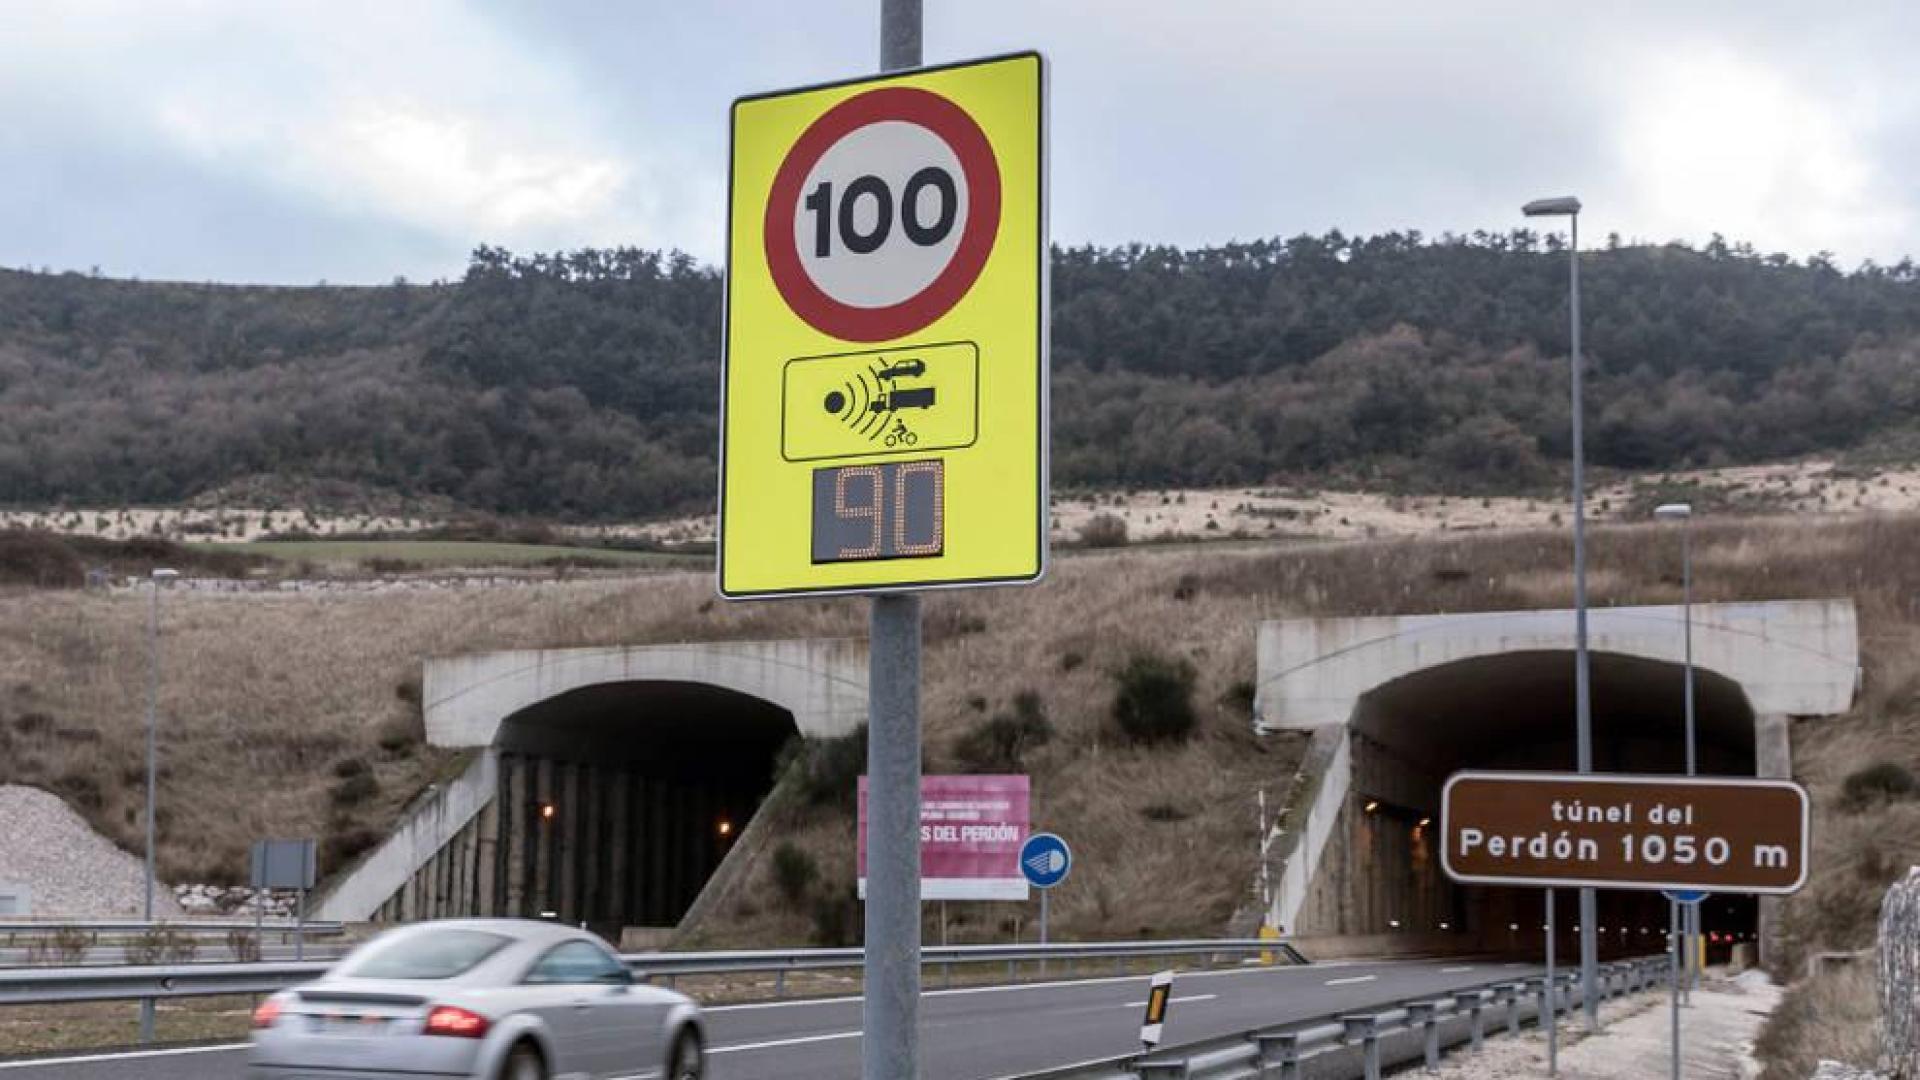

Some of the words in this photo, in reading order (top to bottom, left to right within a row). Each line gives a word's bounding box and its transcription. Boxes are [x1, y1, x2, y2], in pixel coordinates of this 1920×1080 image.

[806, 167, 958, 258] 100
[836, 461, 944, 558] 90
[934, 825, 959, 841] DEL
[962, 822, 1019, 842] PERDÓN
[1552, 800, 1632, 823] túnel
[1648, 804, 1693, 825] del
[1459, 828, 1599, 861] Perdón
[1621, 834, 1730, 865] 1050
[1754, 844, 1788, 868] m
